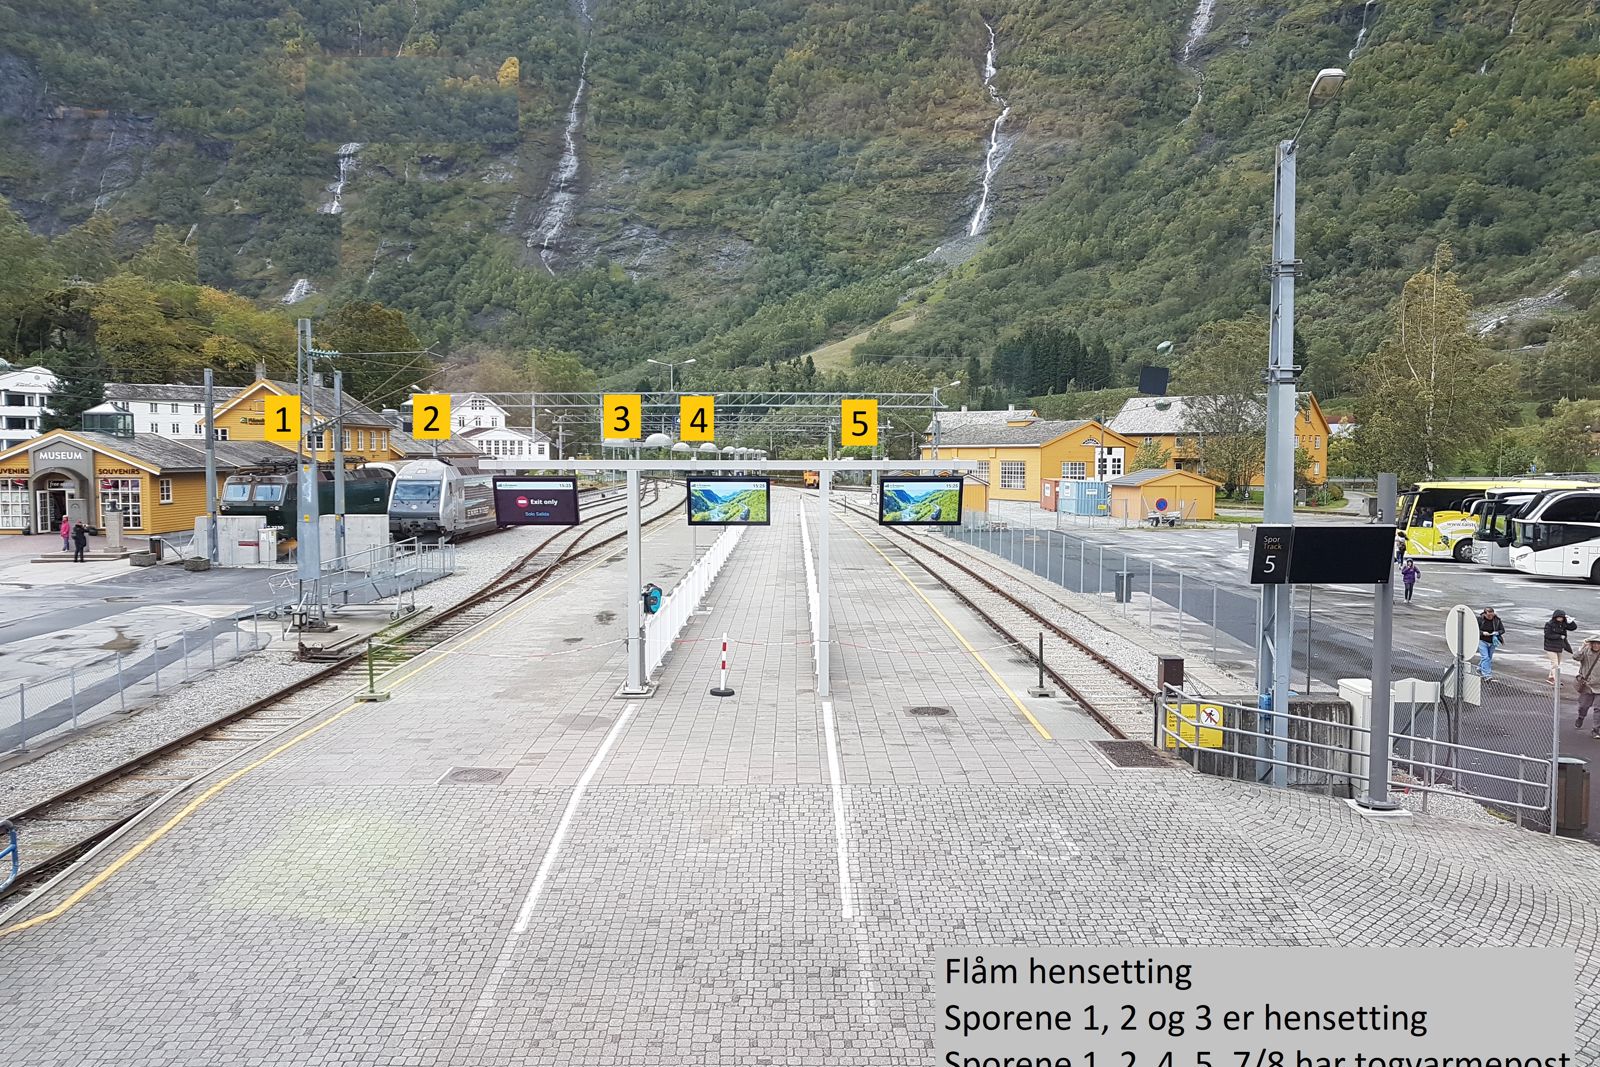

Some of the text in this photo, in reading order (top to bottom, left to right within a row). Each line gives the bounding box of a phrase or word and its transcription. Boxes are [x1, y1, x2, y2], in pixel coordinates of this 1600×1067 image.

[39, 451, 83, 460] MUSEUM
[543, 498, 558, 506] only
[1263, 535, 1281, 545] Spor
[1263, 555, 1277, 574] 5
